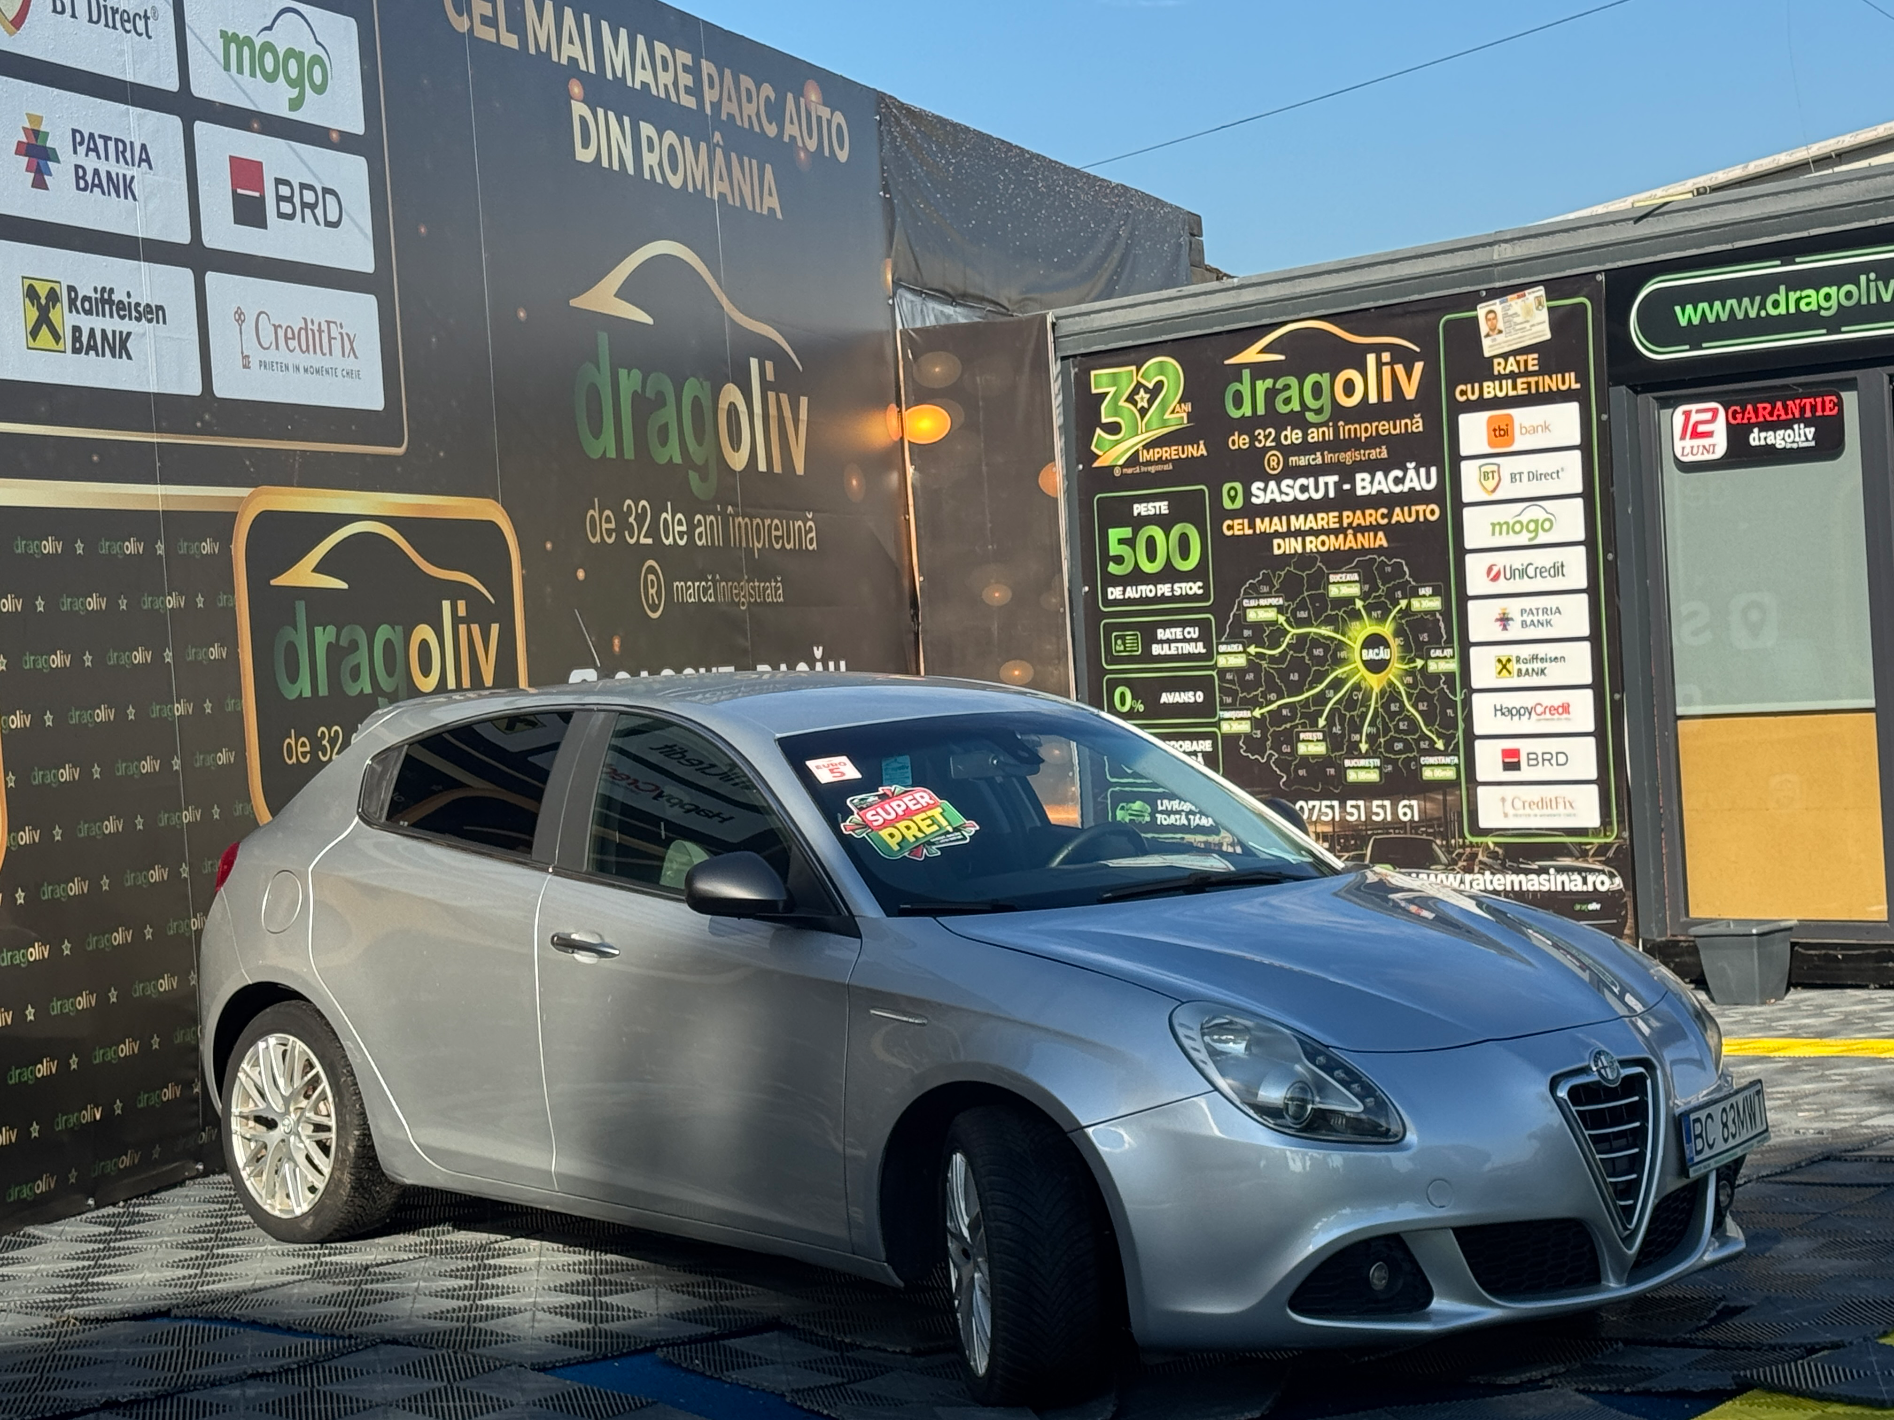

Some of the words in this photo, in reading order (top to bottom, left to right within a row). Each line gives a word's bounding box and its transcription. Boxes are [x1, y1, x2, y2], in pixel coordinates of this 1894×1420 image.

[220, 29, 329, 112] mogo
[524, 0, 596, 74] MAI
[601, 19, 697, 110] MARE
[700, 58, 777, 138] PARC
[783, 92, 850, 163] AUTO
[71, 128, 154, 171] PATRIA
[570, 99, 634, 176] DIN
[638, 119, 783, 220] ROMÂNIA
[74, 164, 138, 202] BANK
[274, 177, 343, 229] BRD
[67, 284, 167, 325] Raiffeisen
[71, 325, 133, 361] BANK
[255, 310, 359, 360] CreditFix
[259, 360, 290, 374] PRIETEN
[293, 362, 301, 374] IN
[304, 363, 339, 378] MOMENTE
[341, 366, 362, 380] CHEIE
[1493, 353, 1539, 375] RATE
[1224, 351, 1424, 424] dragoliv
[1455, 383, 1481, 402] CU
[1482, 372, 1581, 400] BULETINUL
[574, 331, 809, 501] dragoliv
[1090, 356, 1188, 456] 32
[1173, 402, 1192, 414] ANI
[1728, 396, 1839, 425] GARANTIE
[1228, 430, 1250, 450] de
[1254, 428, 1276, 448] 32
[1280, 426, 1303, 445] de
[1308, 422, 1334, 443] ani
[1339, 413, 1424, 442] împreună
[1491, 423, 1509, 439] tbi
[1519, 420, 1552, 436] bank
[1679, 406, 1720, 441] 12
[1749, 424, 1816, 448] dragoliv
[1139, 440, 1208, 462] ÎMPREUNĂ
[1288, 450, 1323, 468] marcă
[1324, 446, 1388, 466] înregistrată
[1680, 444, 1718, 458] LUNI
[1250, 474, 1339, 505] SASCUT
[1355, 461, 1438, 496] BACĂU
[1482, 470, 1497, 482] BT
[1509, 471, 1524, 484] BT
[1133, 501, 1170, 517] PESTE
[1222, 517, 1254, 537] CEL
[1254, 514, 1288, 535] MAI
[1289, 511, 1342, 533] MARE
[1342, 508, 1391, 528] PARC
[1391, 504, 1441, 524] AUTO
[586, 497, 616, 545] de
[623, 498, 653, 545] 32
[660, 501, 688, 547] de
[694, 504, 723, 547] ani
[728, 505, 817, 559] împreună
[1273, 535, 1303, 555] DIN
[1305, 530, 1389, 554] ROMÂNIA
[1490, 516, 1554, 542] mogo
[14, 536, 62, 558] dragoliv
[98, 537, 144, 558] dragoliv
[177, 538, 220, 558] dragoliv
[1107, 522, 1201, 576] 500
[1503, 560, 1566, 582] UniCredit
[60, 592, 106, 614] dragoliv
[141, 592, 186, 612] dragoliv
[673, 574, 715, 603] marcă
[716, 575, 784, 610] înregistrată
[1107, 586, 1125, 600] DE
[1125, 584, 1156, 599] AUTO
[1156, 583, 1172, 597] PE
[1172, 581, 1204, 596] STOC
[1520, 606, 1562, 617] PATRIA
[1520, 618, 1553, 629] BANK
[1157, 627, 1180, 640] RATE
[1181, 626, 1199, 640] CU
[22, 650, 71, 672] dragoliv
[106, 646, 152, 668] dragoliv
[186, 642, 227, 664] dragoliv
[274, 600, 500, 708] dragoliv
[1151, 641, 1206, 656] BULETINUL
[1362, 646, 1391, 660] BACĂU
[1515, 654, 1566, 665] Raiffeisen
[1516, 666, 1547, 678] BANK
[1113, 685, 1145, 713] 0%
[1160, 691, 1195, 705] AVANS
[1493, 702, 1571, 720] HappyCredit
[68, 704, 115, 727] dragoliv
[150, 699, 194, 720] dragoliv
[283, 728, 310, 765] de
[317, 725, 343, 762] 32
[1526, 751, 1569, 768] BRD
[31, 764, 80, 787] dragoliv
[115, 756, 160, 778] dragoliv
[193, 748, 236, 769] dragoliv
[815, 760, 848, 770] EURO
[828, 768, 846, 778] 5
[866, 791, 934, 826] SUPER
[1295, 800, 1340, 822] 0751
[1346, 800, 1366, 822] 51
[1372, 800, 1392, 822] 51
[1398, 800, 1420, 822] 61
[1511, 796, 1575, 811] CreditFix
[77, 816, 124, 839] dragoliv
[158, 806, 201, 828] dragoliv
[40, 877, 89, 900] dragoliv
[124, 864, 168, 887] dragoliv
[0, 942, 50, 968] dragoliv
[86, 926, 132, 950] dragoliv
[50, 990, 96, 1016] dragoliv
[132, 973, 178, 998] dragoliv
[7, 1057, 58, 1084] dragoliv
[92, 1038, 140, 1064] dragoliv
[54, 1104, 102, 1131] dragoliv
[137, 1082, 181, 1108] dragoliv
[1692, 1112, 1716, 1157] BC
[6, 1174, 56, 1202] dragoliv
